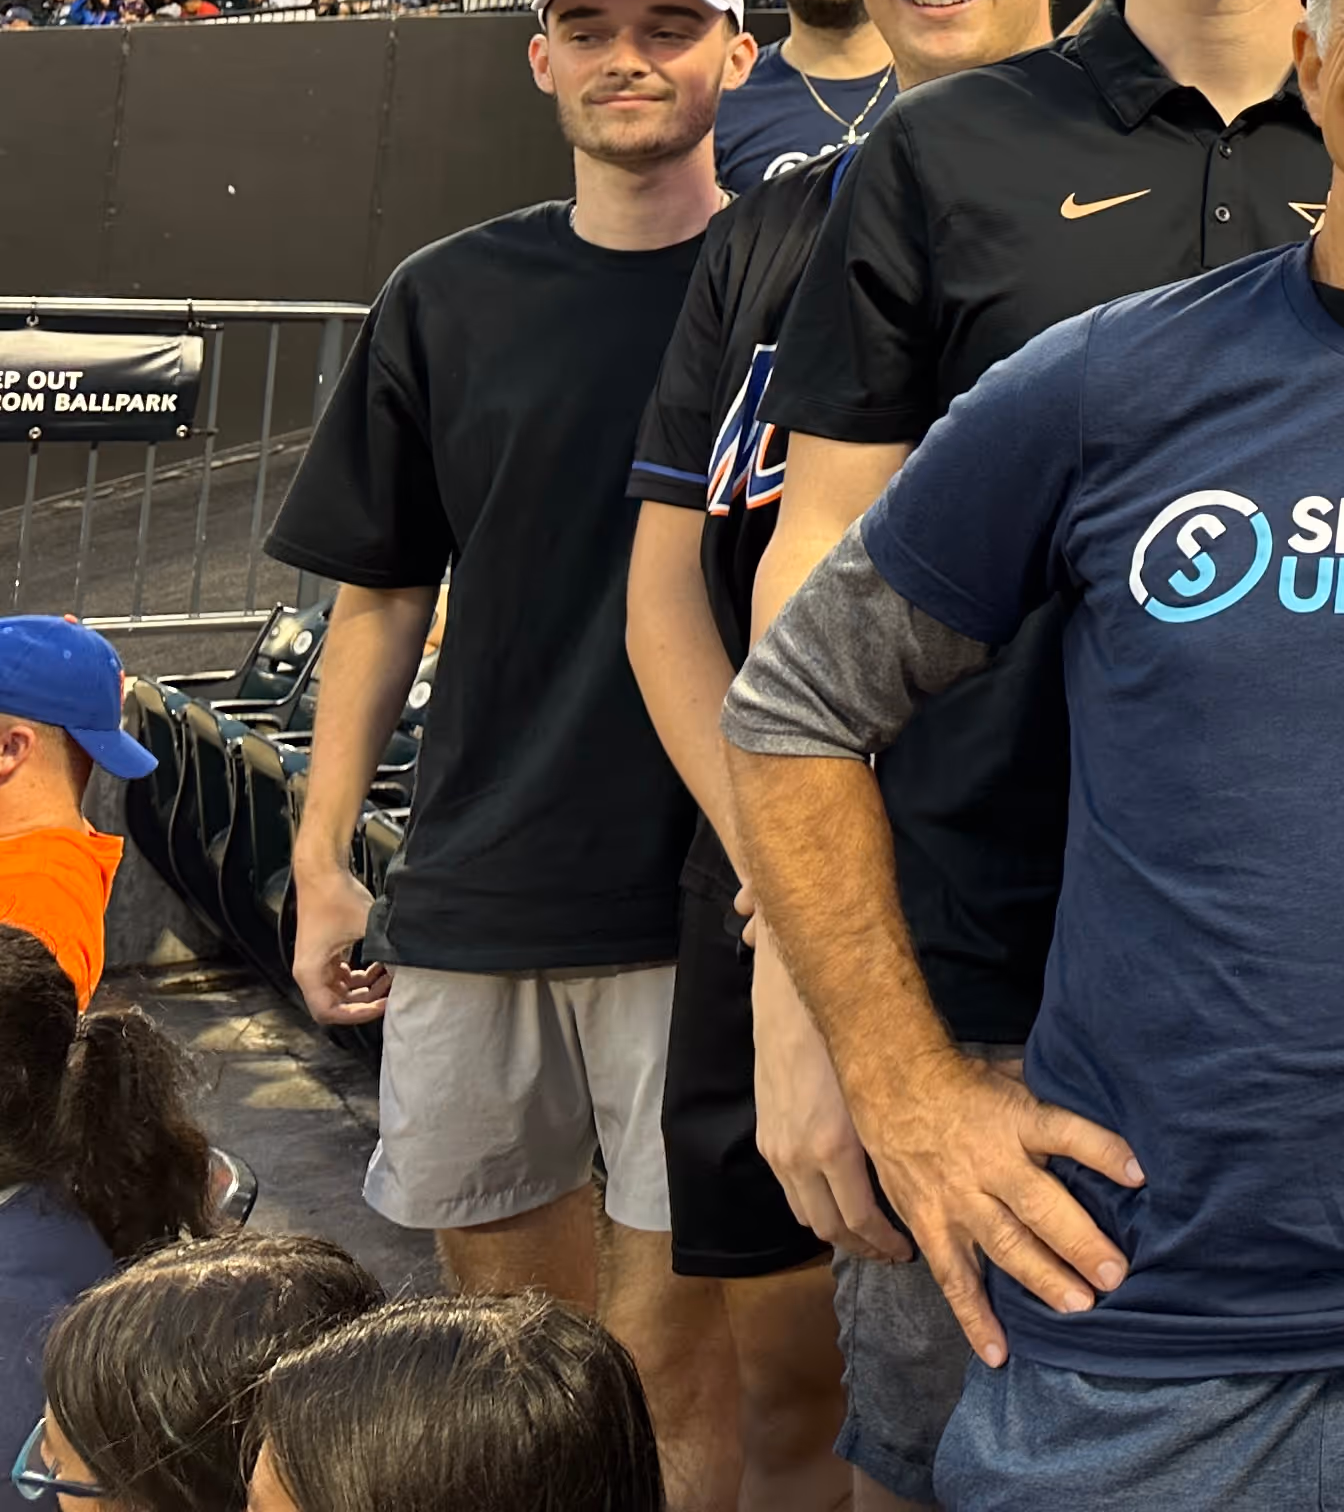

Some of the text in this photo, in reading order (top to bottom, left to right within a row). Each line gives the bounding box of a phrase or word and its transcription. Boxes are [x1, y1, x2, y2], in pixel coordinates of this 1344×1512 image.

[0, 370, 84, 390] P OUT
[0, 392, 178, 412] OM BALLPARK
